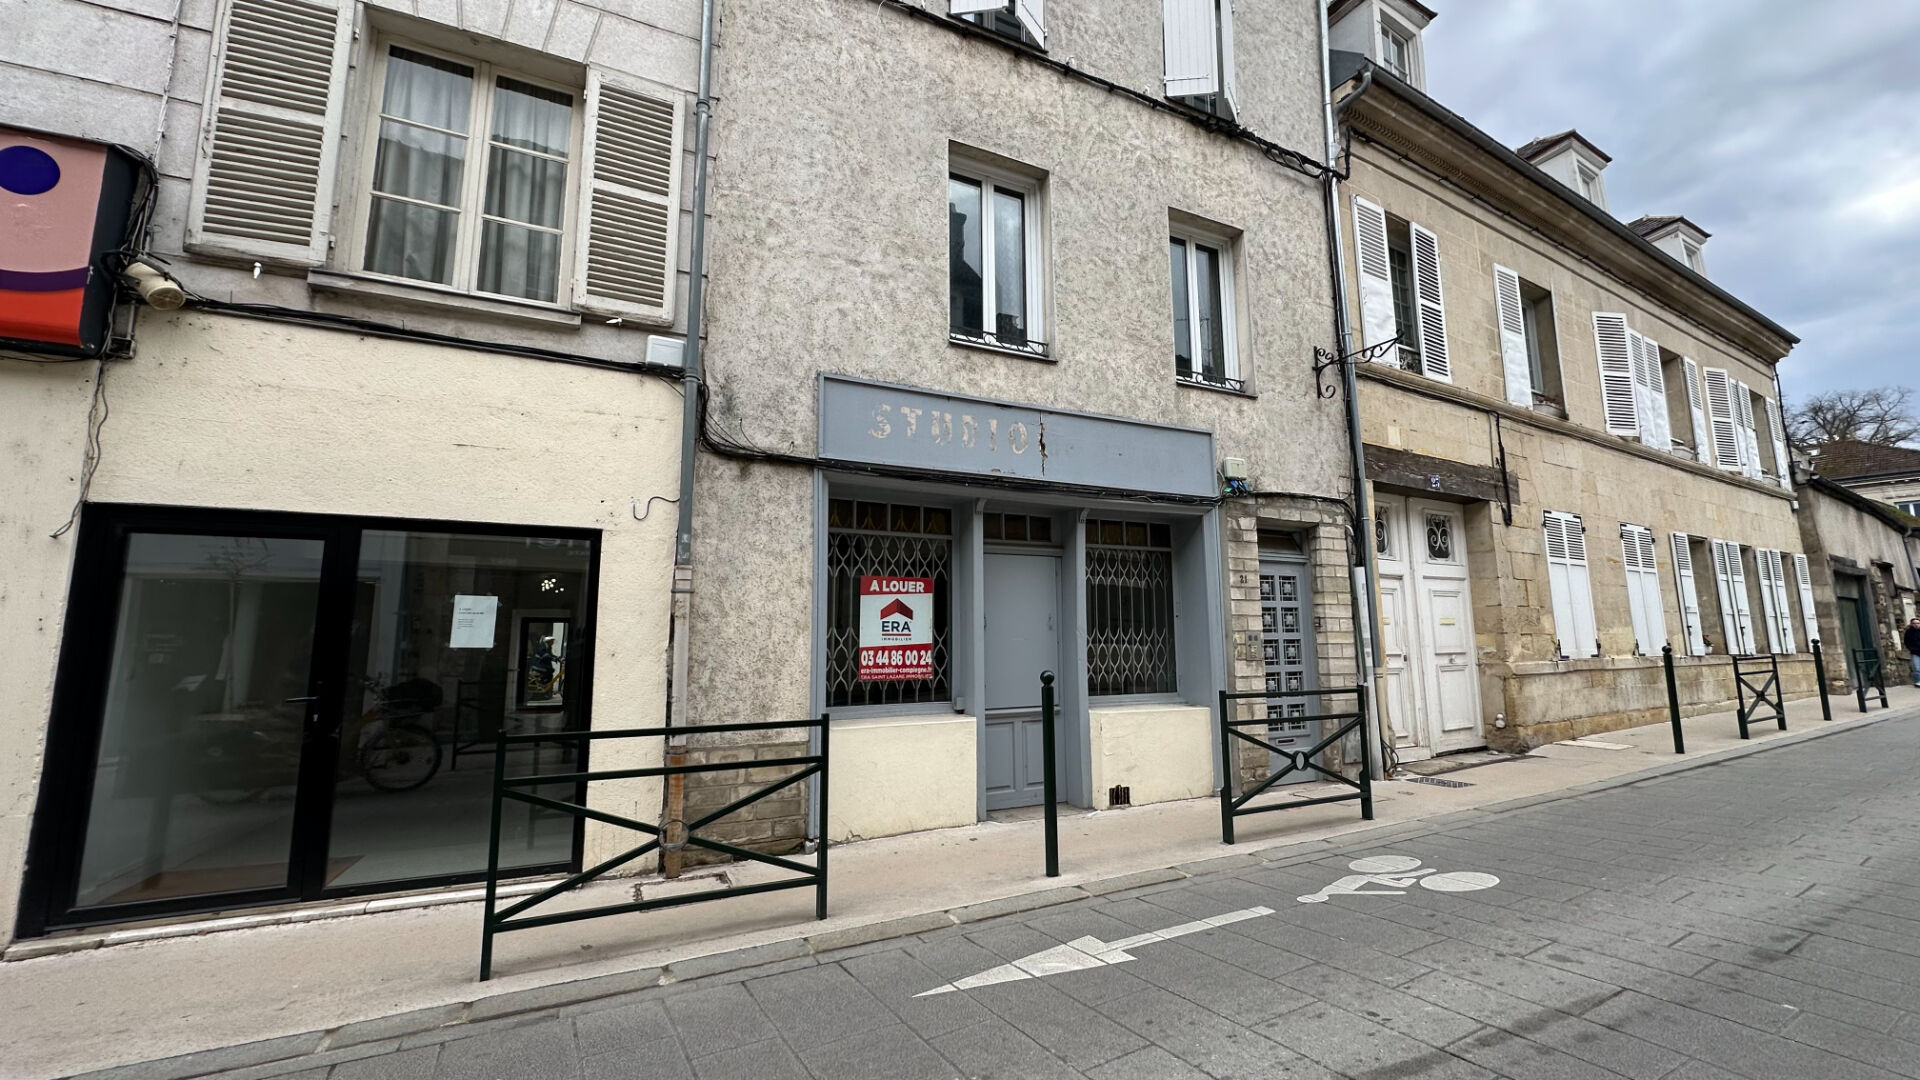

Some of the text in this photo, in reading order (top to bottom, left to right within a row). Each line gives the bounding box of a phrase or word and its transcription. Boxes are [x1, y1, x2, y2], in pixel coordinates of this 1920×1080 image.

[868, 403, 1029, 455] STUDIO
[1239, 575, 1248, 584] 21
[870, 580, 924, 592] A LOUER
[882, 621, 911, 632] ERA
[861, 649, 932, 666] 03 44 86 00 24
